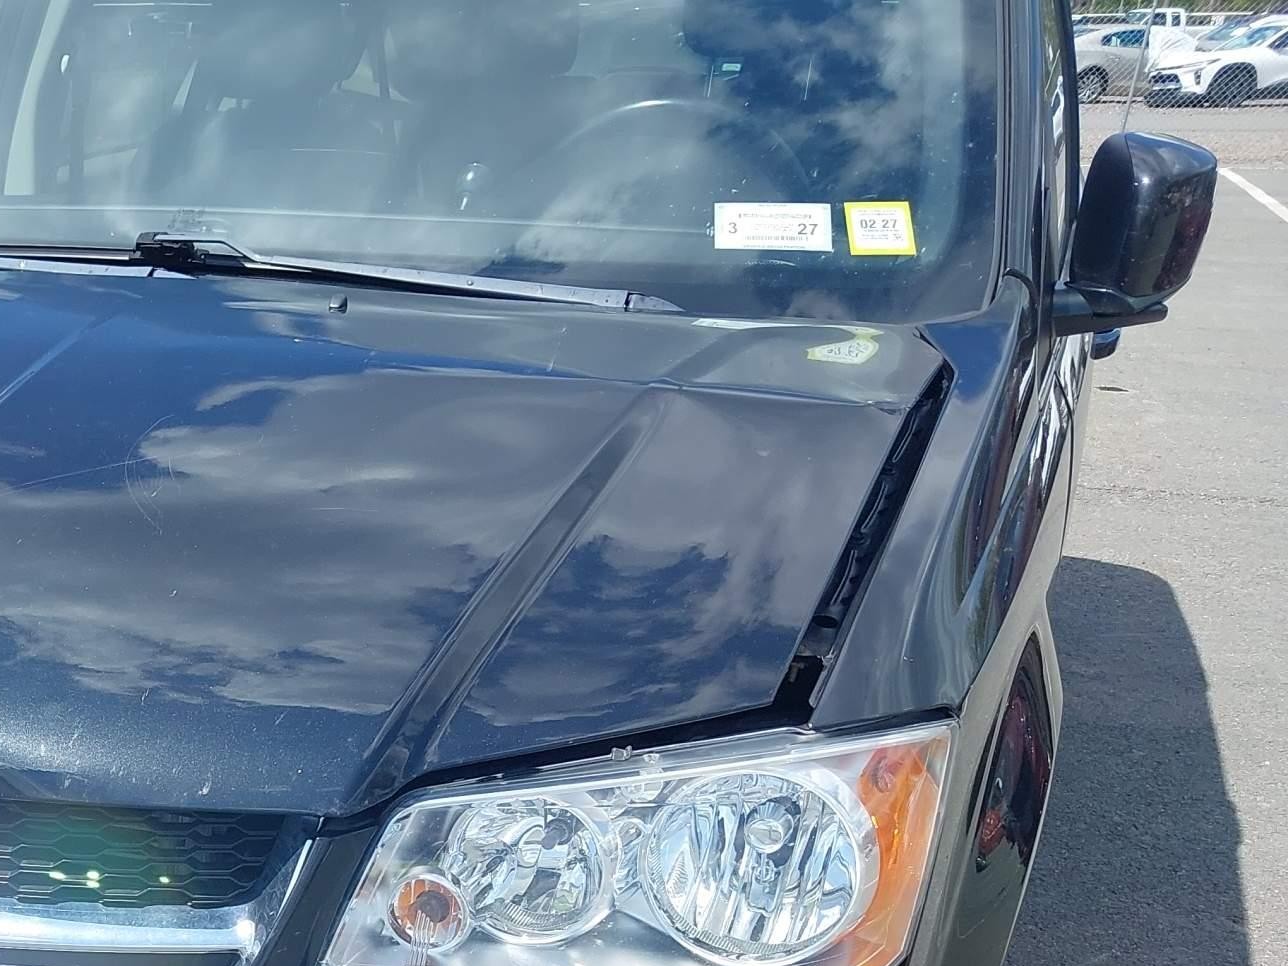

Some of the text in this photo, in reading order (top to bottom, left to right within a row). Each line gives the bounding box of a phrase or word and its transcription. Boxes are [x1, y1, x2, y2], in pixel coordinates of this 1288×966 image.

[797, 223, 818, 236] 27
[860, 219, 898, 229] 02 27
